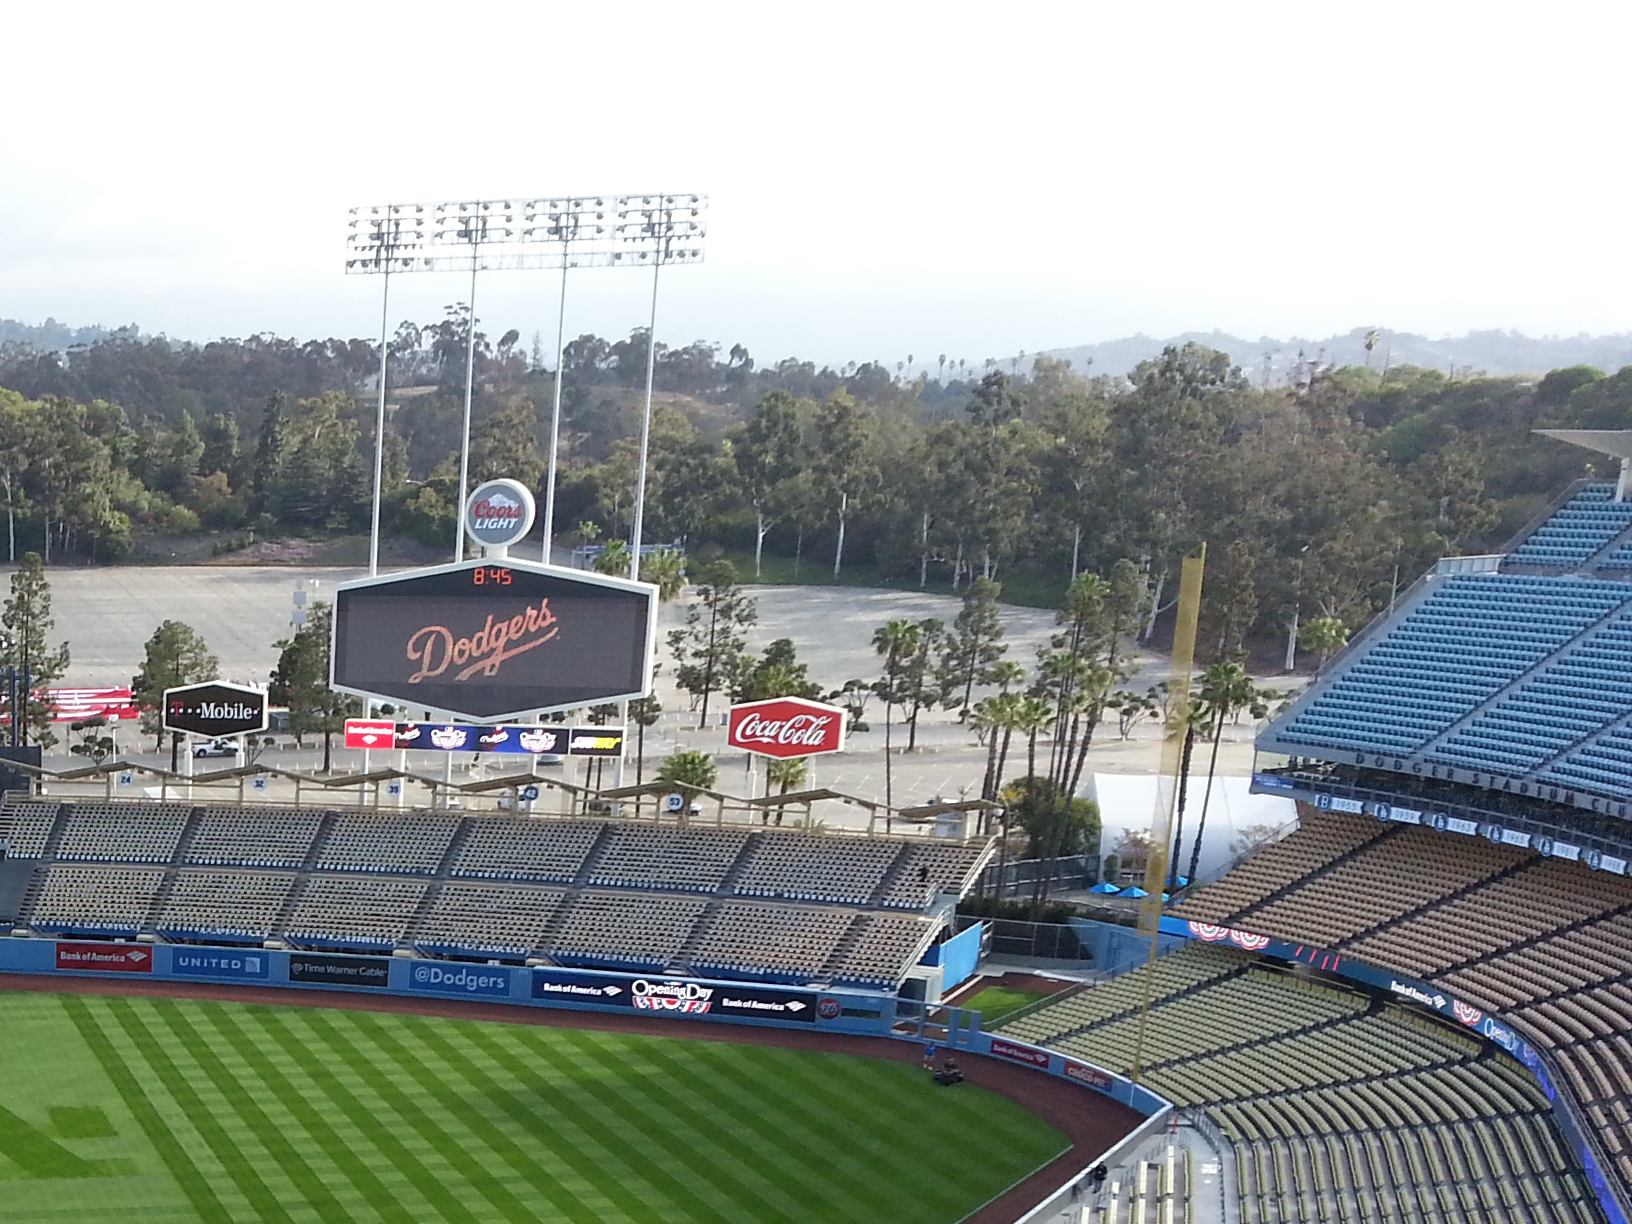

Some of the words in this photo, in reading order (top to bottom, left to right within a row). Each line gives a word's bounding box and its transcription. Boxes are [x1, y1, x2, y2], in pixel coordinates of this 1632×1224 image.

[474, 499, 522, 519] Coors
[474, 517, 519, 530] LIGHT
[473, 567, 512, 585] 8:45
[406, 597, 560, 684] Dodgers
[734, 712, 834, 747] Coca-Cola
[1356, 753, 1455, 779] DODGER
[1472, 773, 1575, 803] STADIUM
[60, 951, 81, 961] Bank
[82, 952, 90, 961] of
[91, 952, 125, 963] America
[178, 957, 241, 969] UNITED
[304, 962, 324, 974] Time
[325, 965, 357, 975] Warner
[358, 966, 385, 978] Cable
[414, 966, 505, 990] @Dodgers
[543, 983, 563, 993] Bank
[563, 984, 571, 994] of
[571, 985, 602, 996] America
[631, 979, 686, 1000] Opening
[686, 983, 713, 1001] Day
[722, 998, 743, 1009] Bank
[743, 1000, 751, 1009] of
[751, 1000, 785, 1012] America
[820, 1002, 837, 1015] 76
